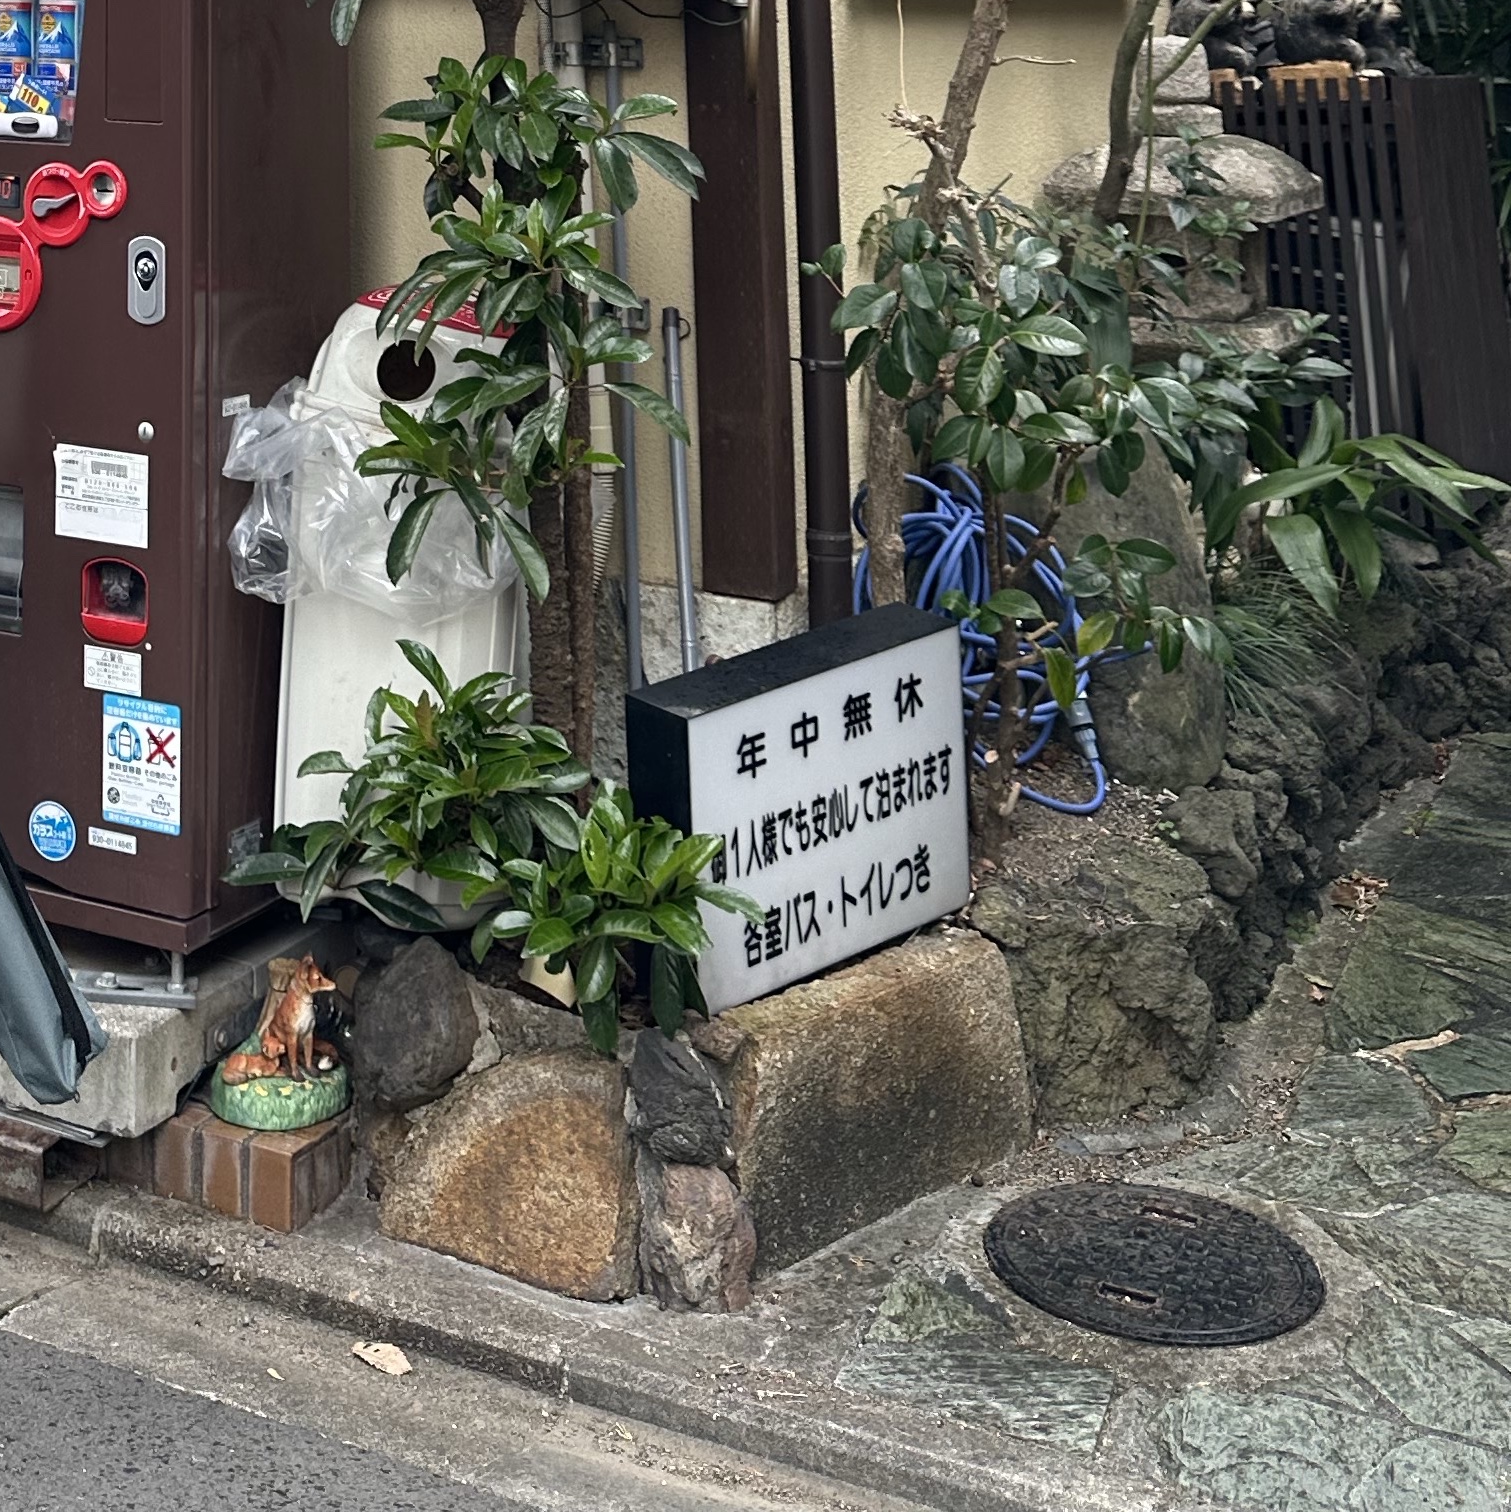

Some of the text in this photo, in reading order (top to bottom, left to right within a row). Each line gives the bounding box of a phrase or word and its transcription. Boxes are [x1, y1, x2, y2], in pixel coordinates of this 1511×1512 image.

[736, 672, 924, 779] 年中無休
[744, 844, 931, 968] 各室バス・トイレつき
